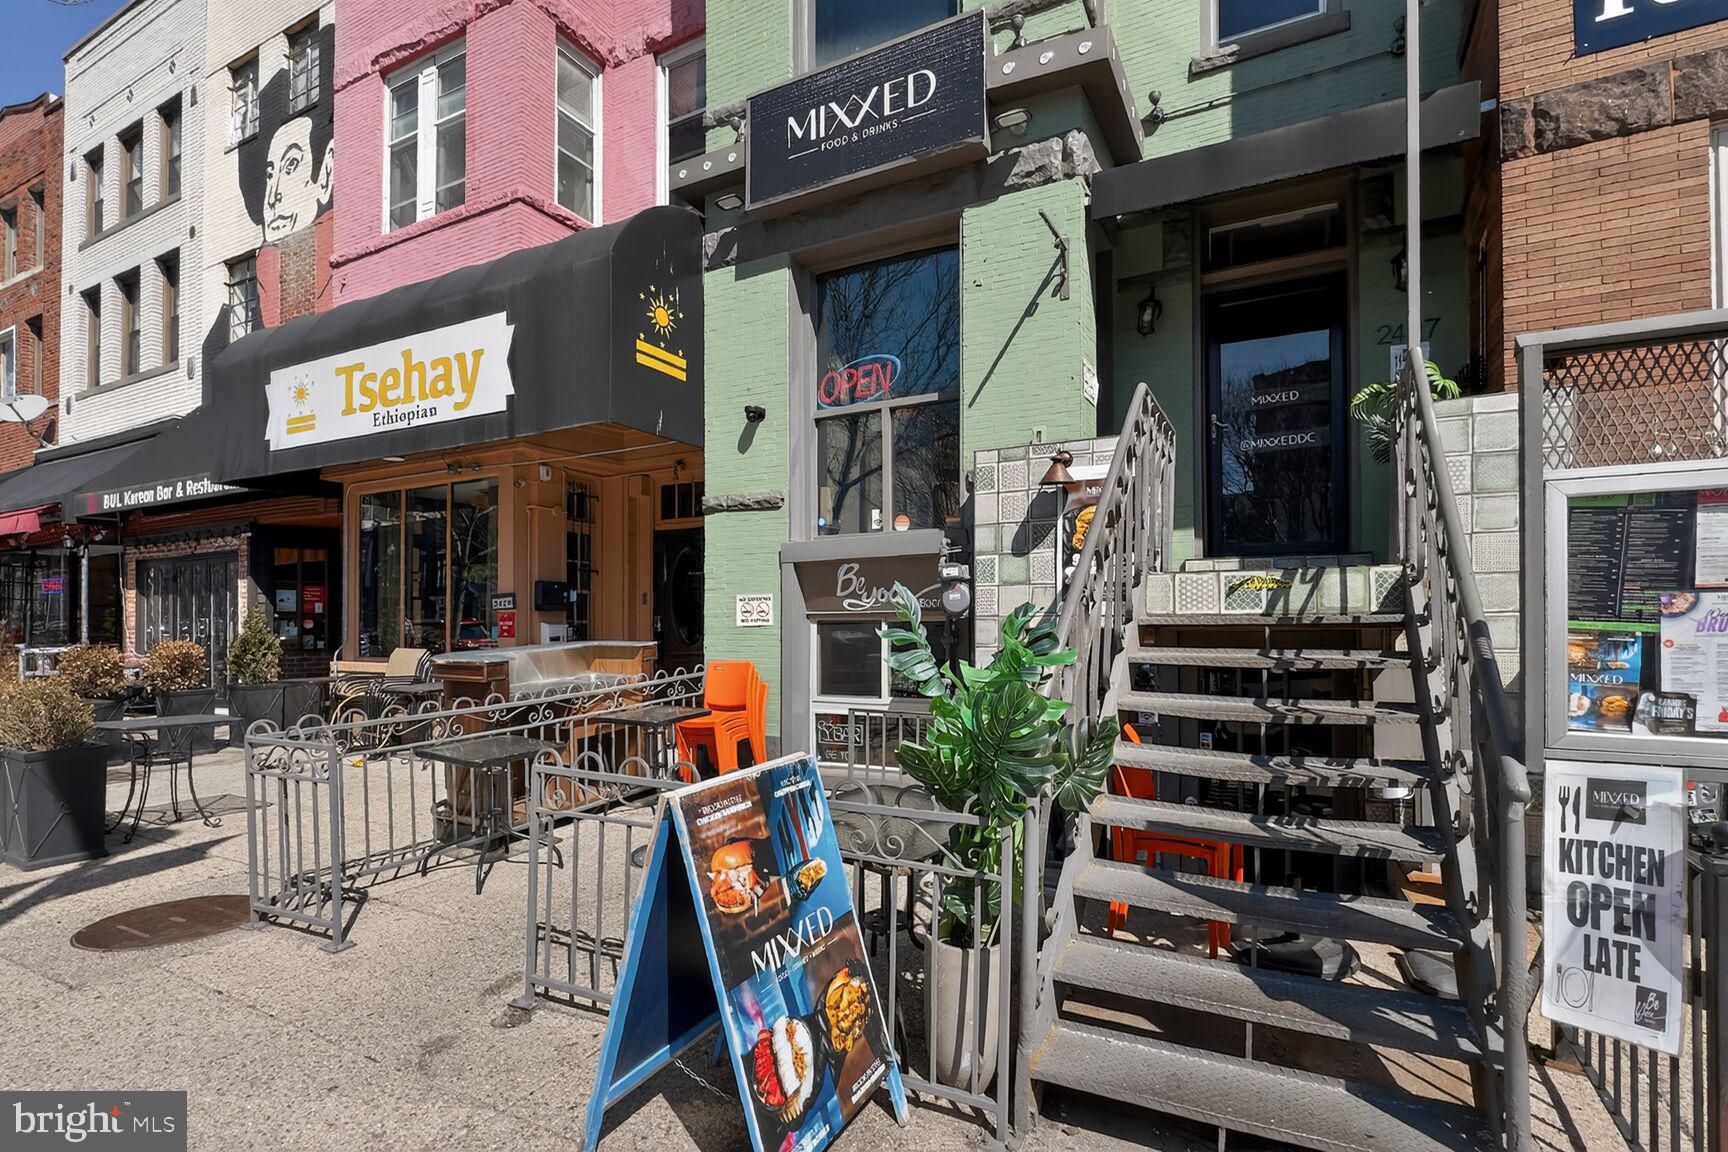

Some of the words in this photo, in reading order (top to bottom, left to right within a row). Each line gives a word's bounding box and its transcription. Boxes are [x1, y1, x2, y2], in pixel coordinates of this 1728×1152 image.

[787, 69, 937, 149] MIXXED
[821, 134, 850, 152] FOOD
[852, 131, 859, 143] &
[862, 119, 899, 139] DRINKS
[1376, 317, 1442, 346] 247
[335, 348, 485, 417] Tsehay
[820, 361, 893, 405] OPEN
[1251, 390, 1300, 407] MIXXED
[372, 406, 438, 428] Ethiopian
[1240, 432, 1317, 452] @MIXXEDDC
[103, 494, 123, 510] BUL
[124, 488, 155, 506] Korean
[156, 485, 174, 501] Bar
[176, 481, 184, 498] &
[836, 563, 867, 597] Be
[1593, 790, 1640, 805] MIXXED
[1558, 837, 1665, 888] KITCHEN
[1566, 880, 1656, 943] OPEN
[751, 906, 833, 983] MIXXED
[1583, 934, 1642, 983] LATE
